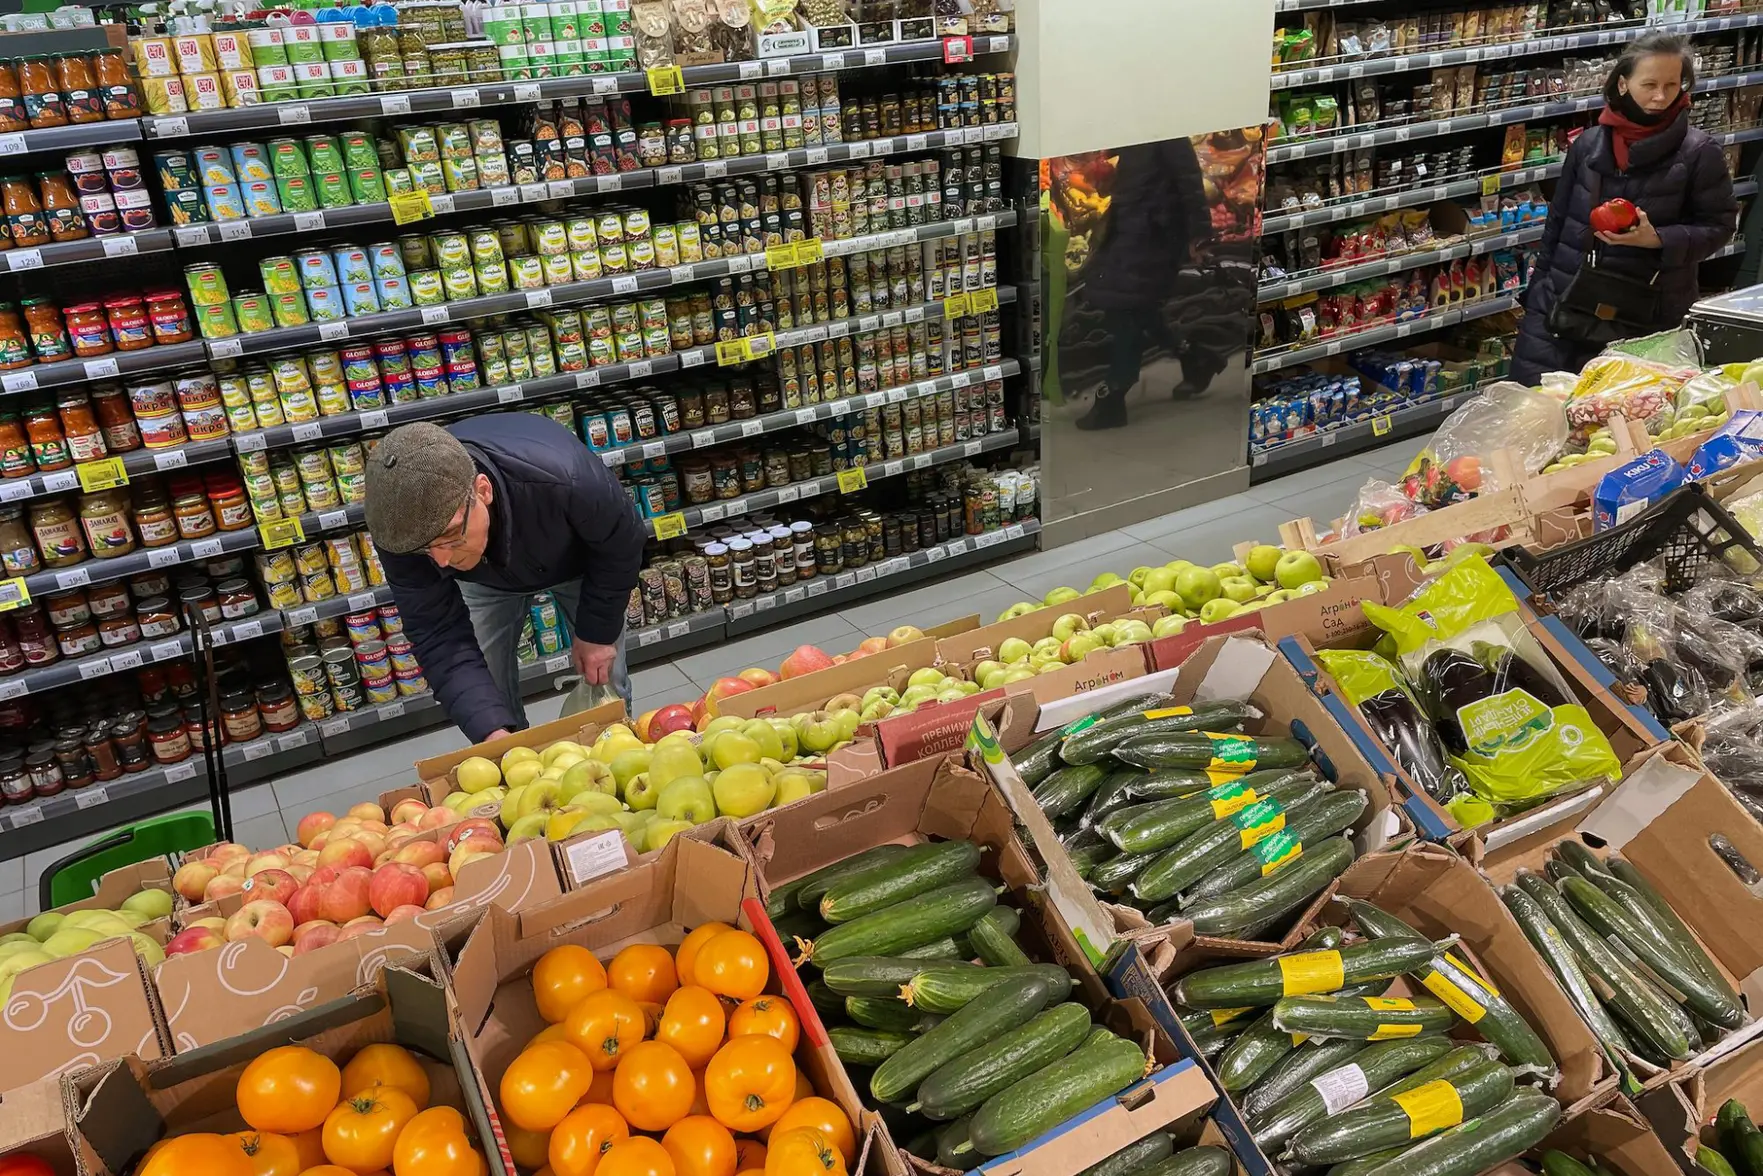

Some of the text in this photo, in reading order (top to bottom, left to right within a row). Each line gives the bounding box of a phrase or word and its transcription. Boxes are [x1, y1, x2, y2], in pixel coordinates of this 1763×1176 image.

[415, 338, 437, 347] GLOBUS
[380, 344, 404, 352] GLOBUS
[346, 350, 370, 358] GLOBUS
[454, 362, 475, 371] GLOBUS
[357, 379, 379, 388] GLOBUS
[185, 392, 214, 402] икра
[137, 402, 166, 410] икра
[193, 423, 222, 433] икра
[1624, 462, 1650, 478] KIKU
[1320, 596, 1362, 616] Агроно
[365, 650, 386, 660] GLOBUS
[396, 668, 419, 677] GLOBUS
[369, 676, 391, 685] GLOBUS
[1074, 670, 1124, 692] Агроном
